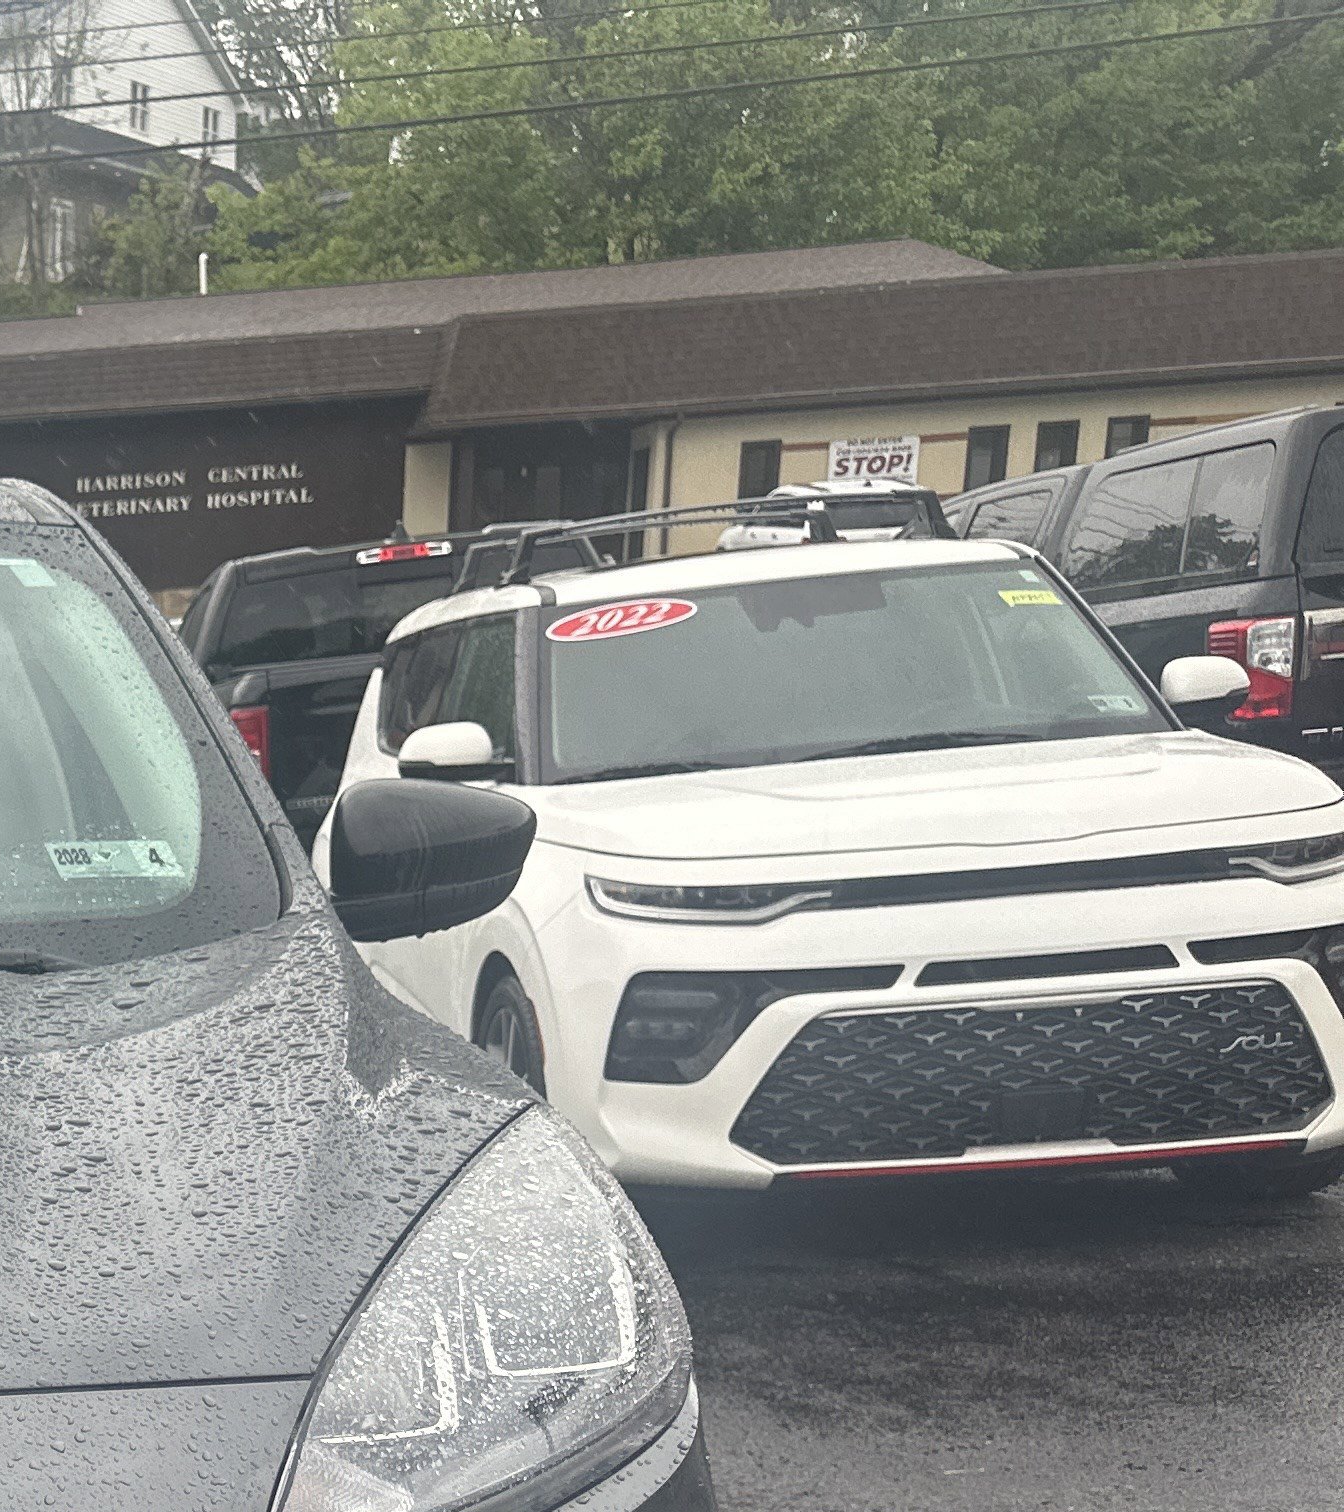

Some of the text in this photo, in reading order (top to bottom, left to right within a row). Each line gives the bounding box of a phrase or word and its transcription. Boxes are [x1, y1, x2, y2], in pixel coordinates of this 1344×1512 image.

[833, 453, 912, 477] STOP!
[76, 461, 304, 494] HARRISON CENTRAL
[206, 487, 314, 510] HOSPITAL
[569, 602, 672, 637] 2022
[1219, 1031, 1294, 1053] SOUL
